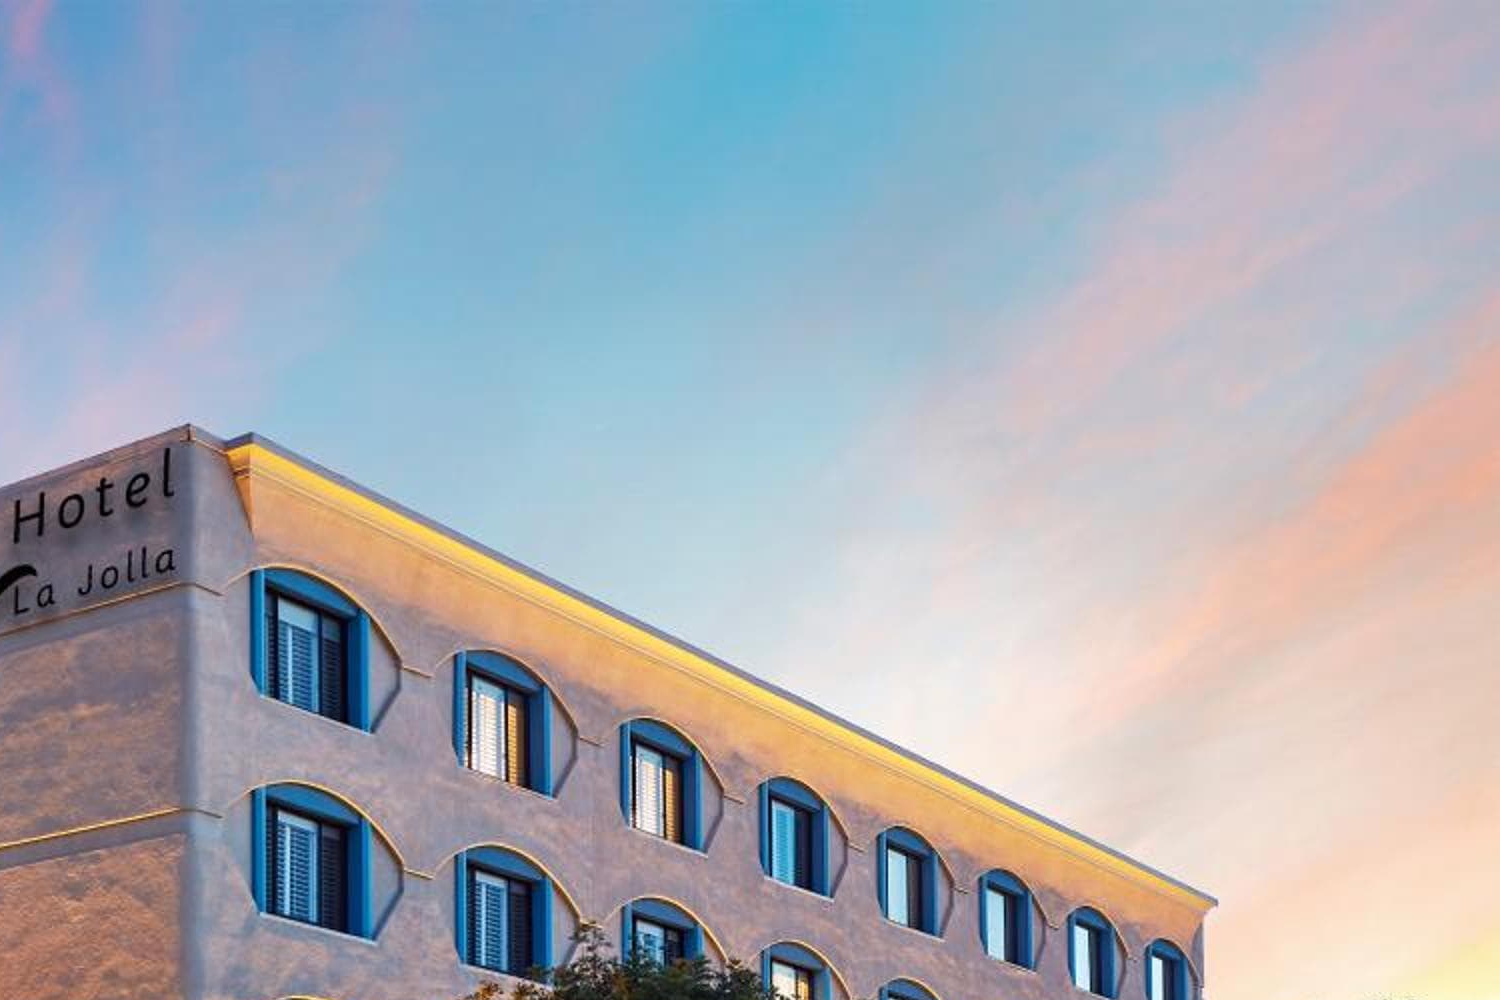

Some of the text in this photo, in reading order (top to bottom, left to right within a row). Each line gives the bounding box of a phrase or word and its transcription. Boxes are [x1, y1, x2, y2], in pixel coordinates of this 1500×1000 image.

[13, 447, 176, 544] Hotel
[13, 546, 177, 616] La Jolla
